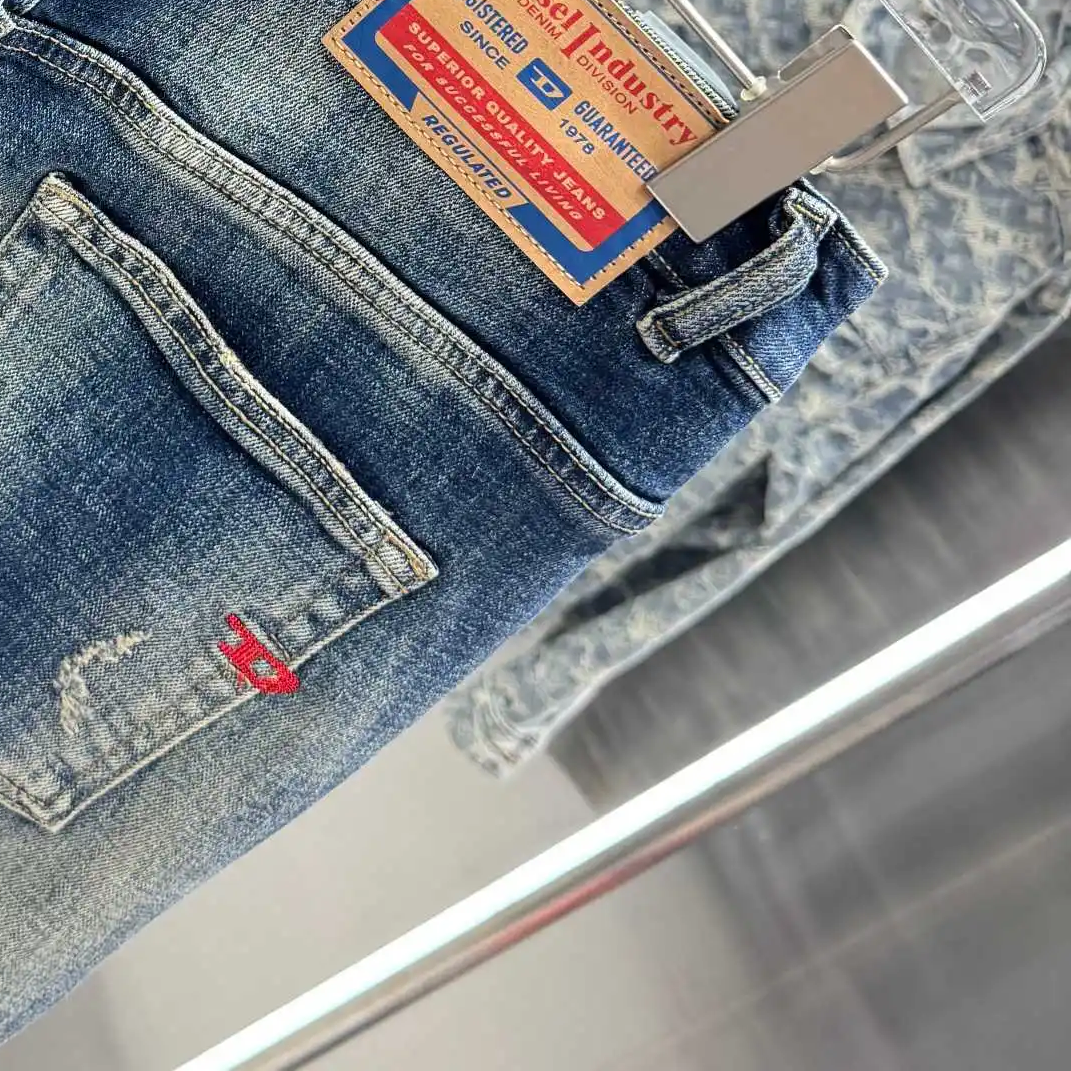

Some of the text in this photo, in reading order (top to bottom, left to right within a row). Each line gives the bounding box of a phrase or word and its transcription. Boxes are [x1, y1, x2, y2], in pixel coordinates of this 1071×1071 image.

[403, 44, 584, 221] FOR SUCCESSFUL LIVING
[408, 21, 607, 221] SUPERIOR QUALITY JEANS
[460, 20, 595, 155] SINCE 1978
[561, 23, 698, 146] Industry
[574, 100, 658, 182] GUARANTEED
[576, 55, 638, 114] DIVISION
[422, 114, 513, 200] REGULATED
